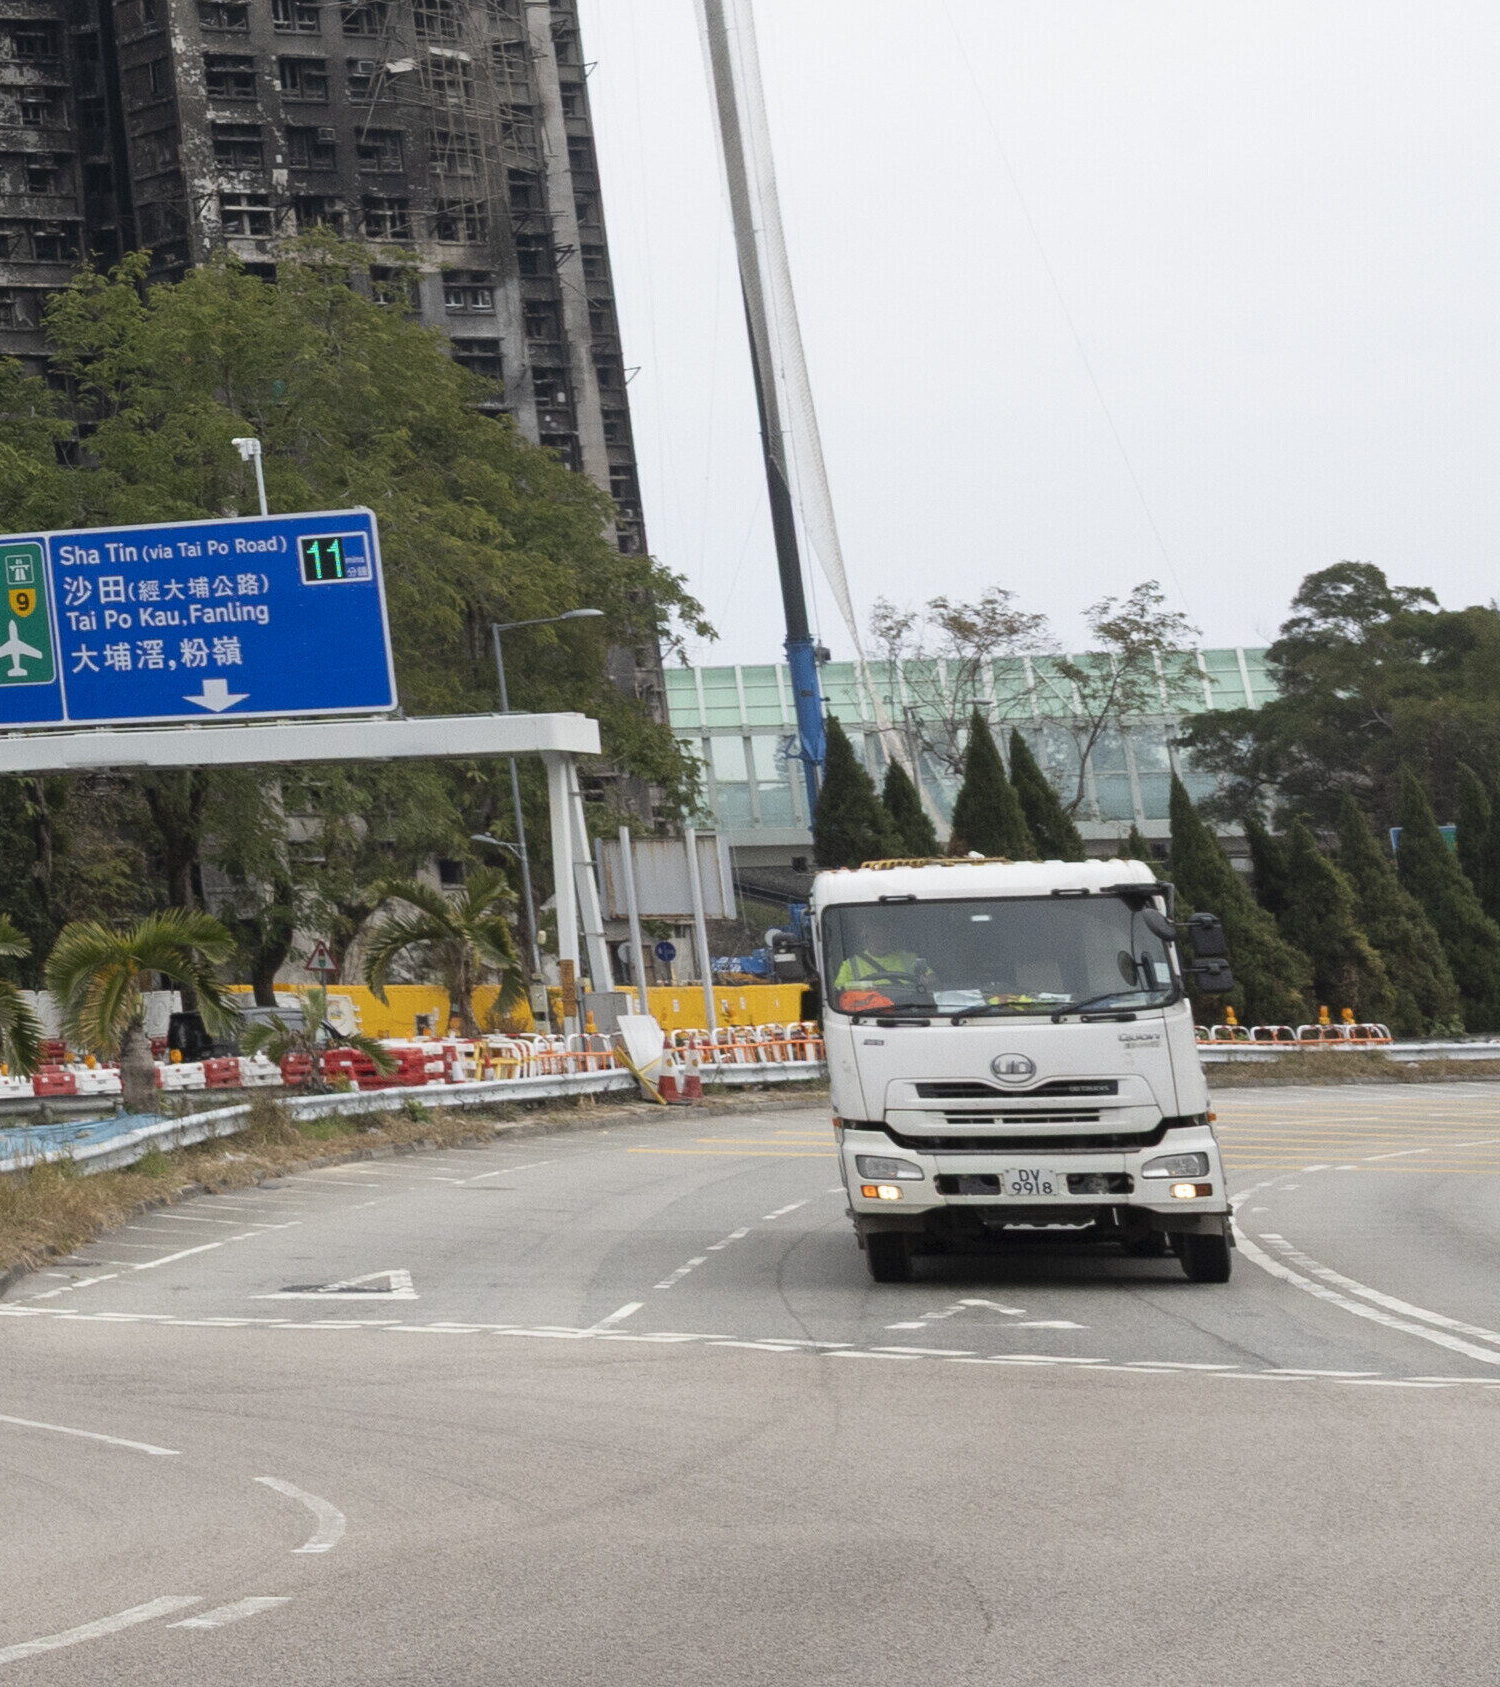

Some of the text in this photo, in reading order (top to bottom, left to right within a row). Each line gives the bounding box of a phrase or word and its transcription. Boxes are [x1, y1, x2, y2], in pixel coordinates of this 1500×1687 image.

[59, 535, 288, 566] Sha Tin (via Tai Po Road)
[306, 538, 343, 579] 11
[344, 555, 365, 564] mins
[15, 592, 30, 611] 9
[66, 610, 98, 632] Tai
[104, 609, 132, 630] Po
[1018, 1169, 1040, 1182] DV
[1011, 1181, 1053, 1195] 9918
